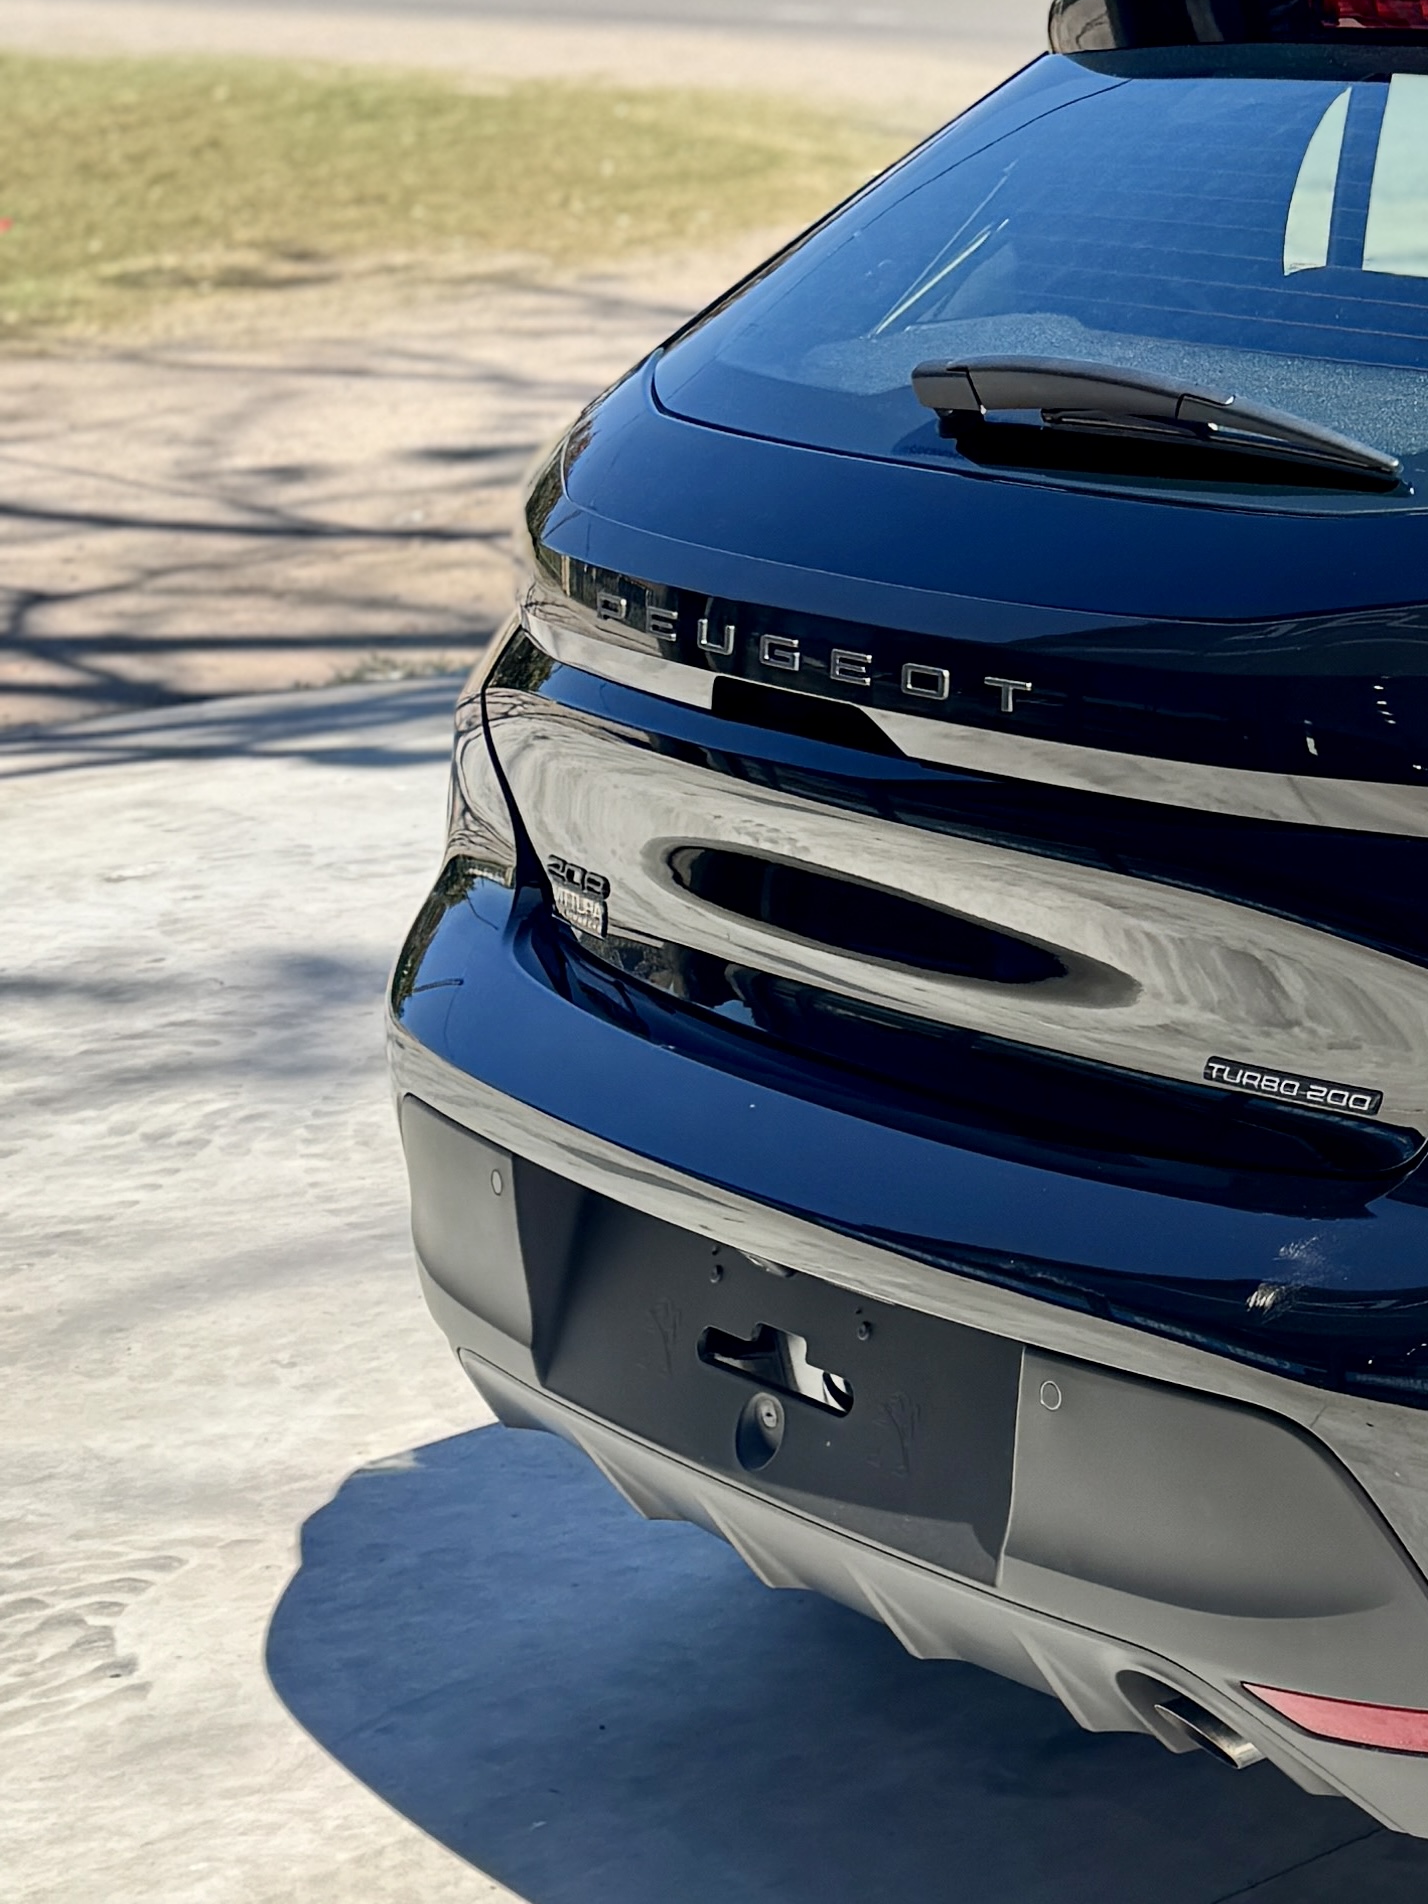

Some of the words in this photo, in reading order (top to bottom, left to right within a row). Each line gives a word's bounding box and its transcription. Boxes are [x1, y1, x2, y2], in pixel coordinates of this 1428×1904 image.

[596, 590, 1033, 713] PEUGEOT
[1208, 1062, 1300, 1096] TURBO
[1306, 1085, 1372, 1112] 200
